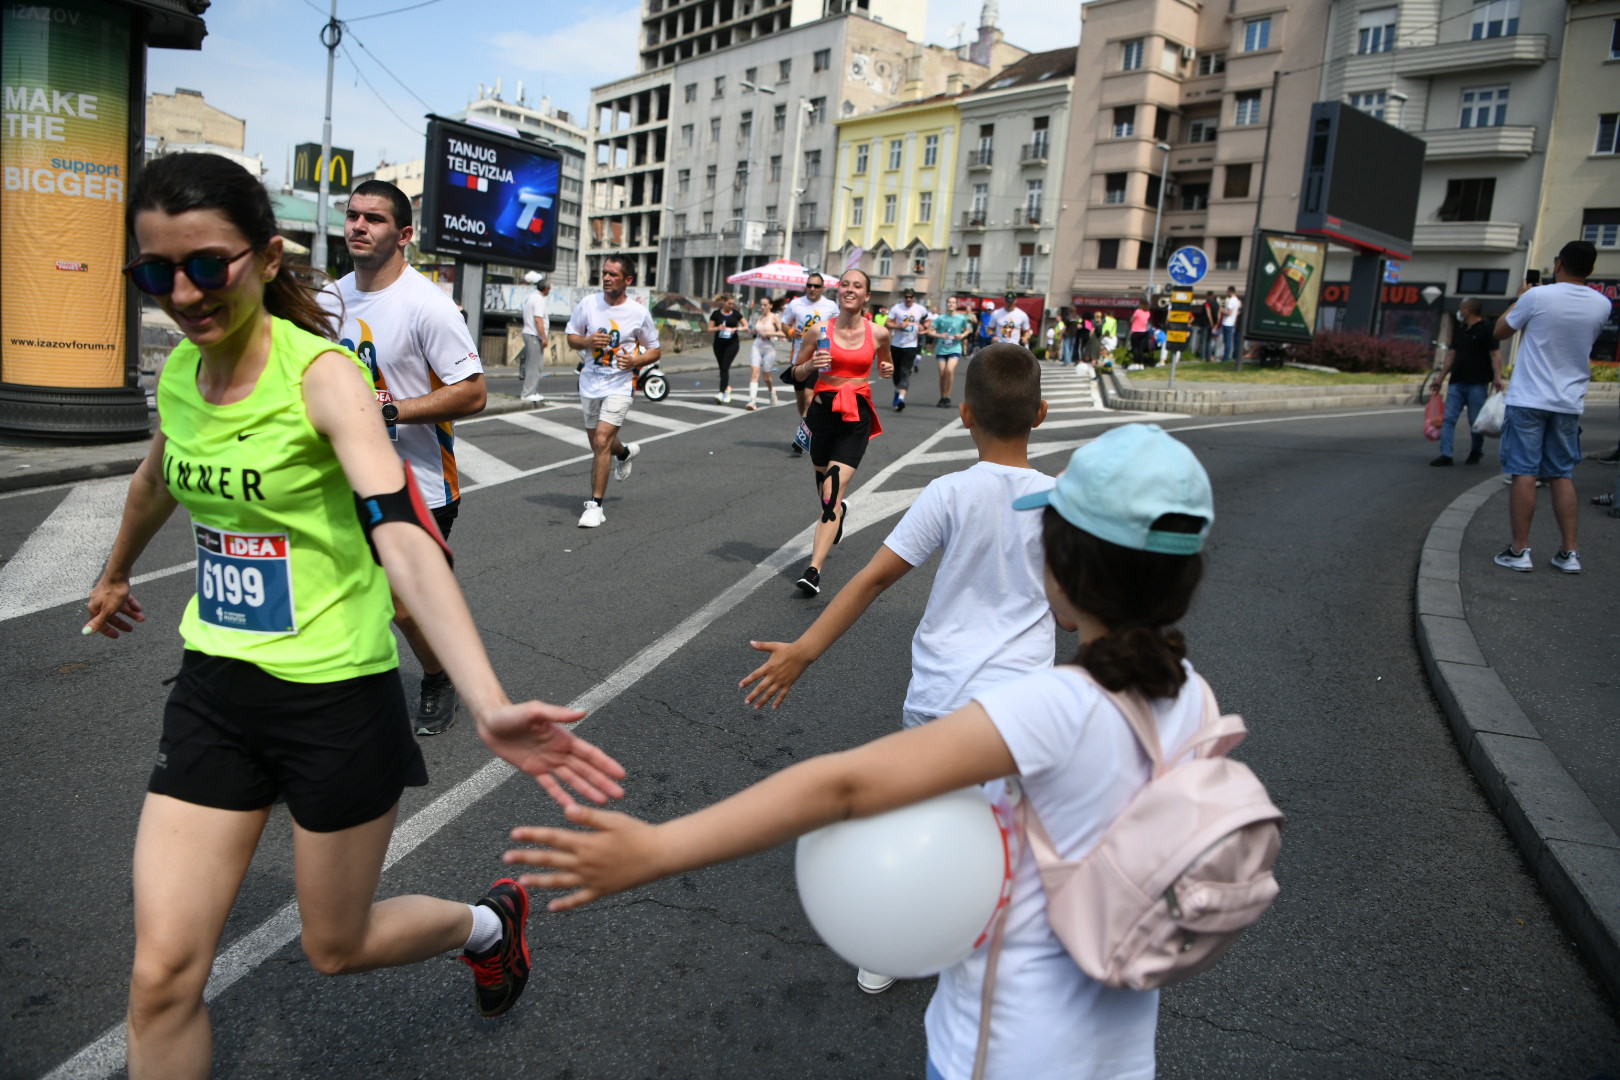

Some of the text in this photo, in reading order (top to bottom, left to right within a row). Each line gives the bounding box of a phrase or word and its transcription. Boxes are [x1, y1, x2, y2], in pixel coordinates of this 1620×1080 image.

[12, 3, 81, 26] IZAZOV
[5, 86, 98, 120] MAKE
[5, 113, 65, 141] THE
[448, 138, 497, 163] TANJUG
[51, 158, 120, 177] support
[4, 166, 124, 203] BIGGER
[1587, 282, 1620, 299] MA
[10, 338, 116, 351] www.izazovforum.rs
[203, 559, 265, 608] 6199
